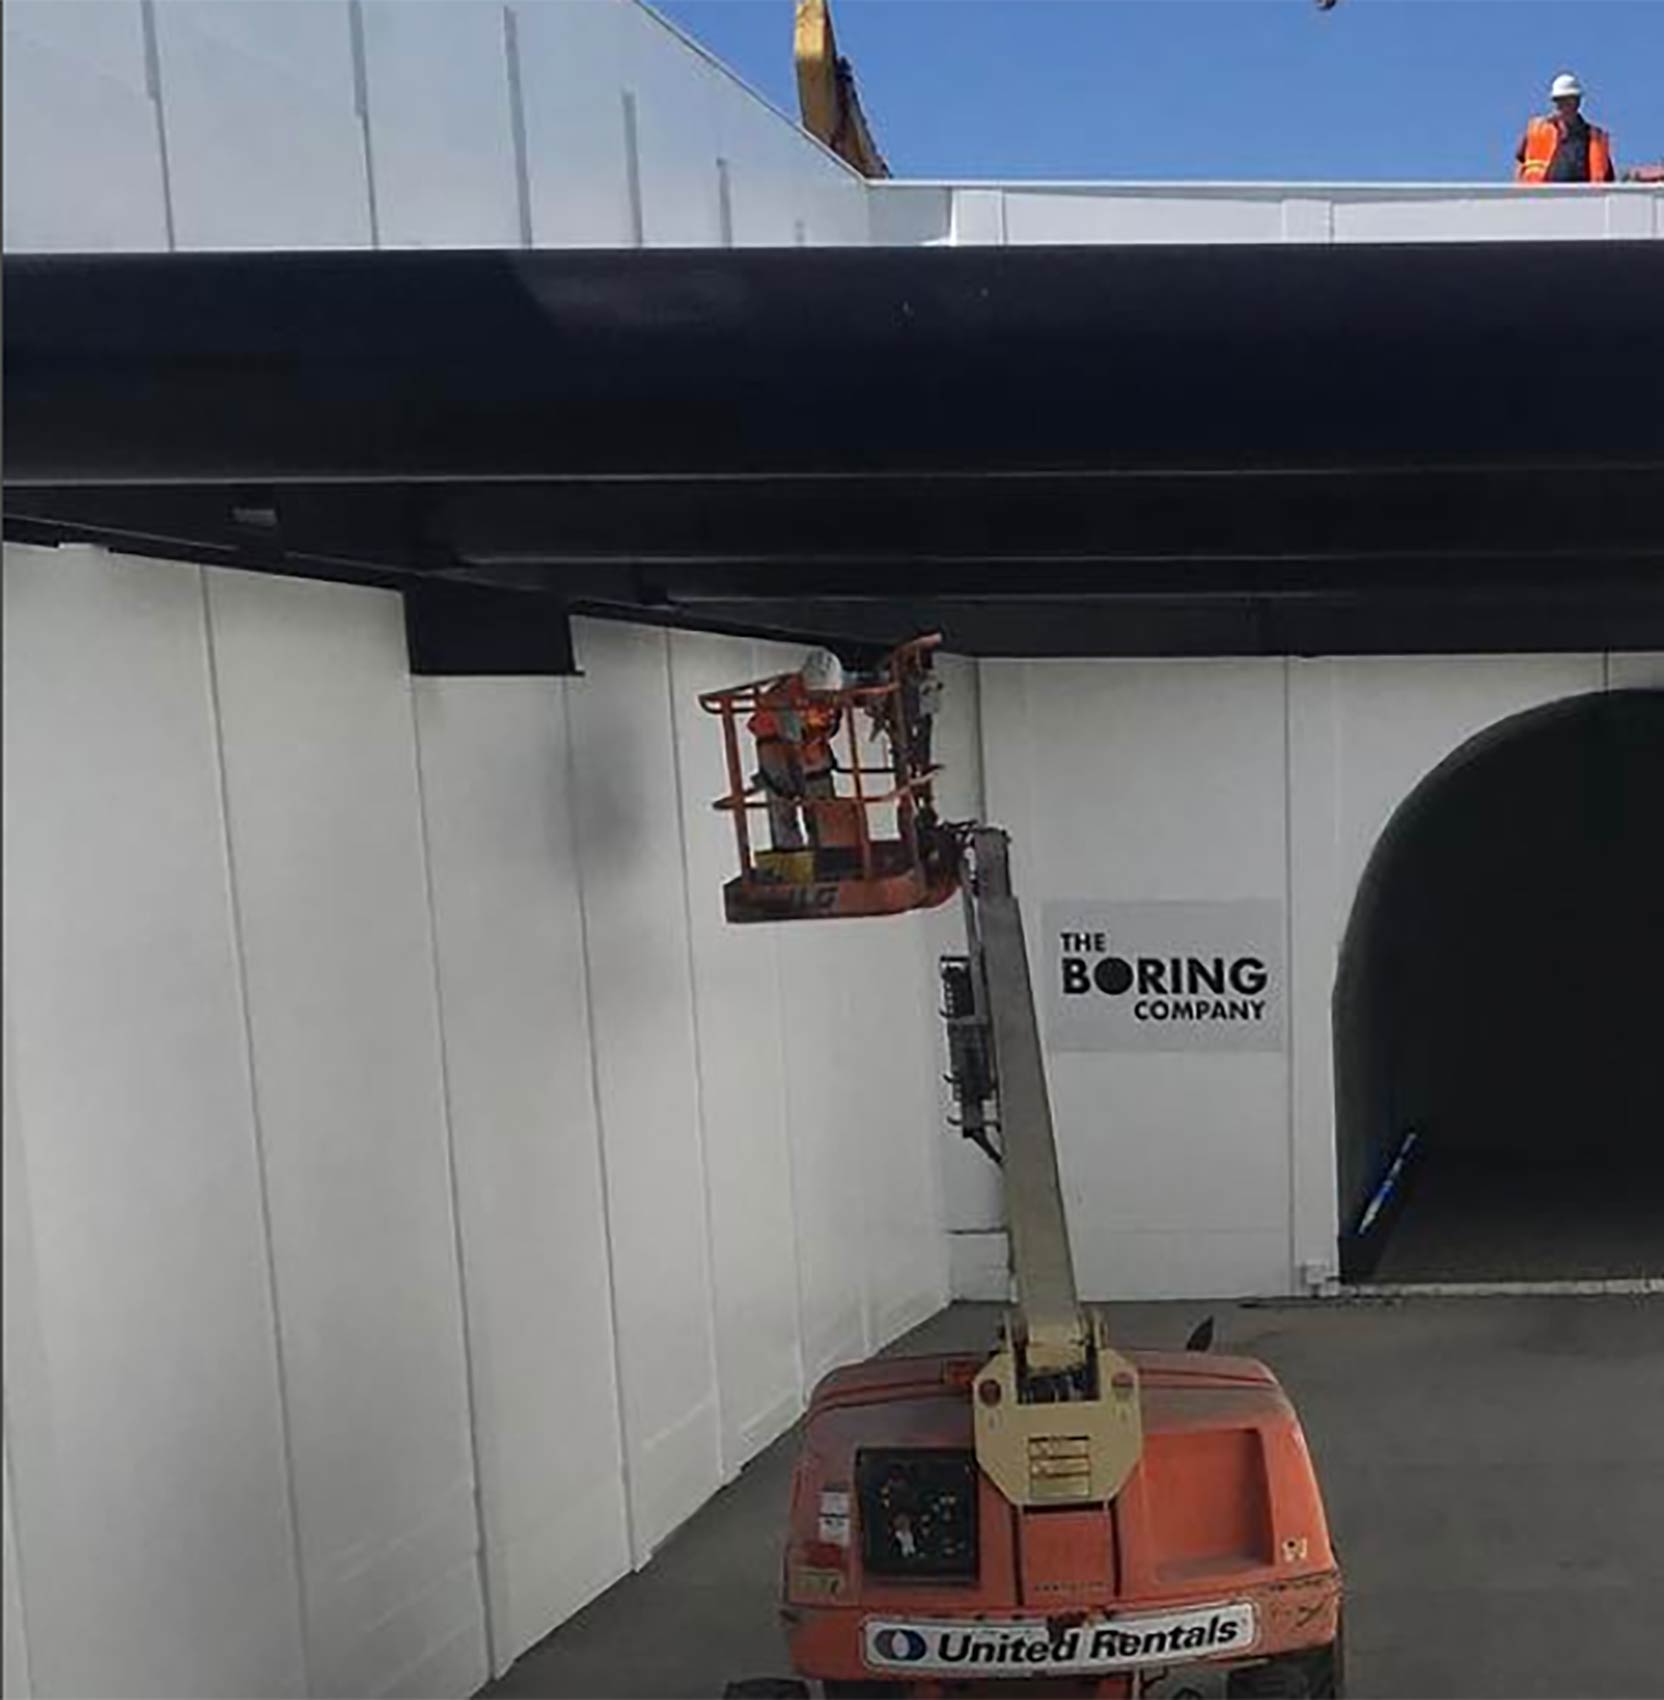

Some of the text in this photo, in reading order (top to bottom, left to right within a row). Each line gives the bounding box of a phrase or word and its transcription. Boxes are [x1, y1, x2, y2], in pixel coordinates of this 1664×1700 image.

[1060, 932, 1106, 952] THE
[1061, 957, 1268, 996] BORING
[1134, 1000, 1266, 1021] COMPANY
[938, 1615, 1238, 1663] United Rentals
